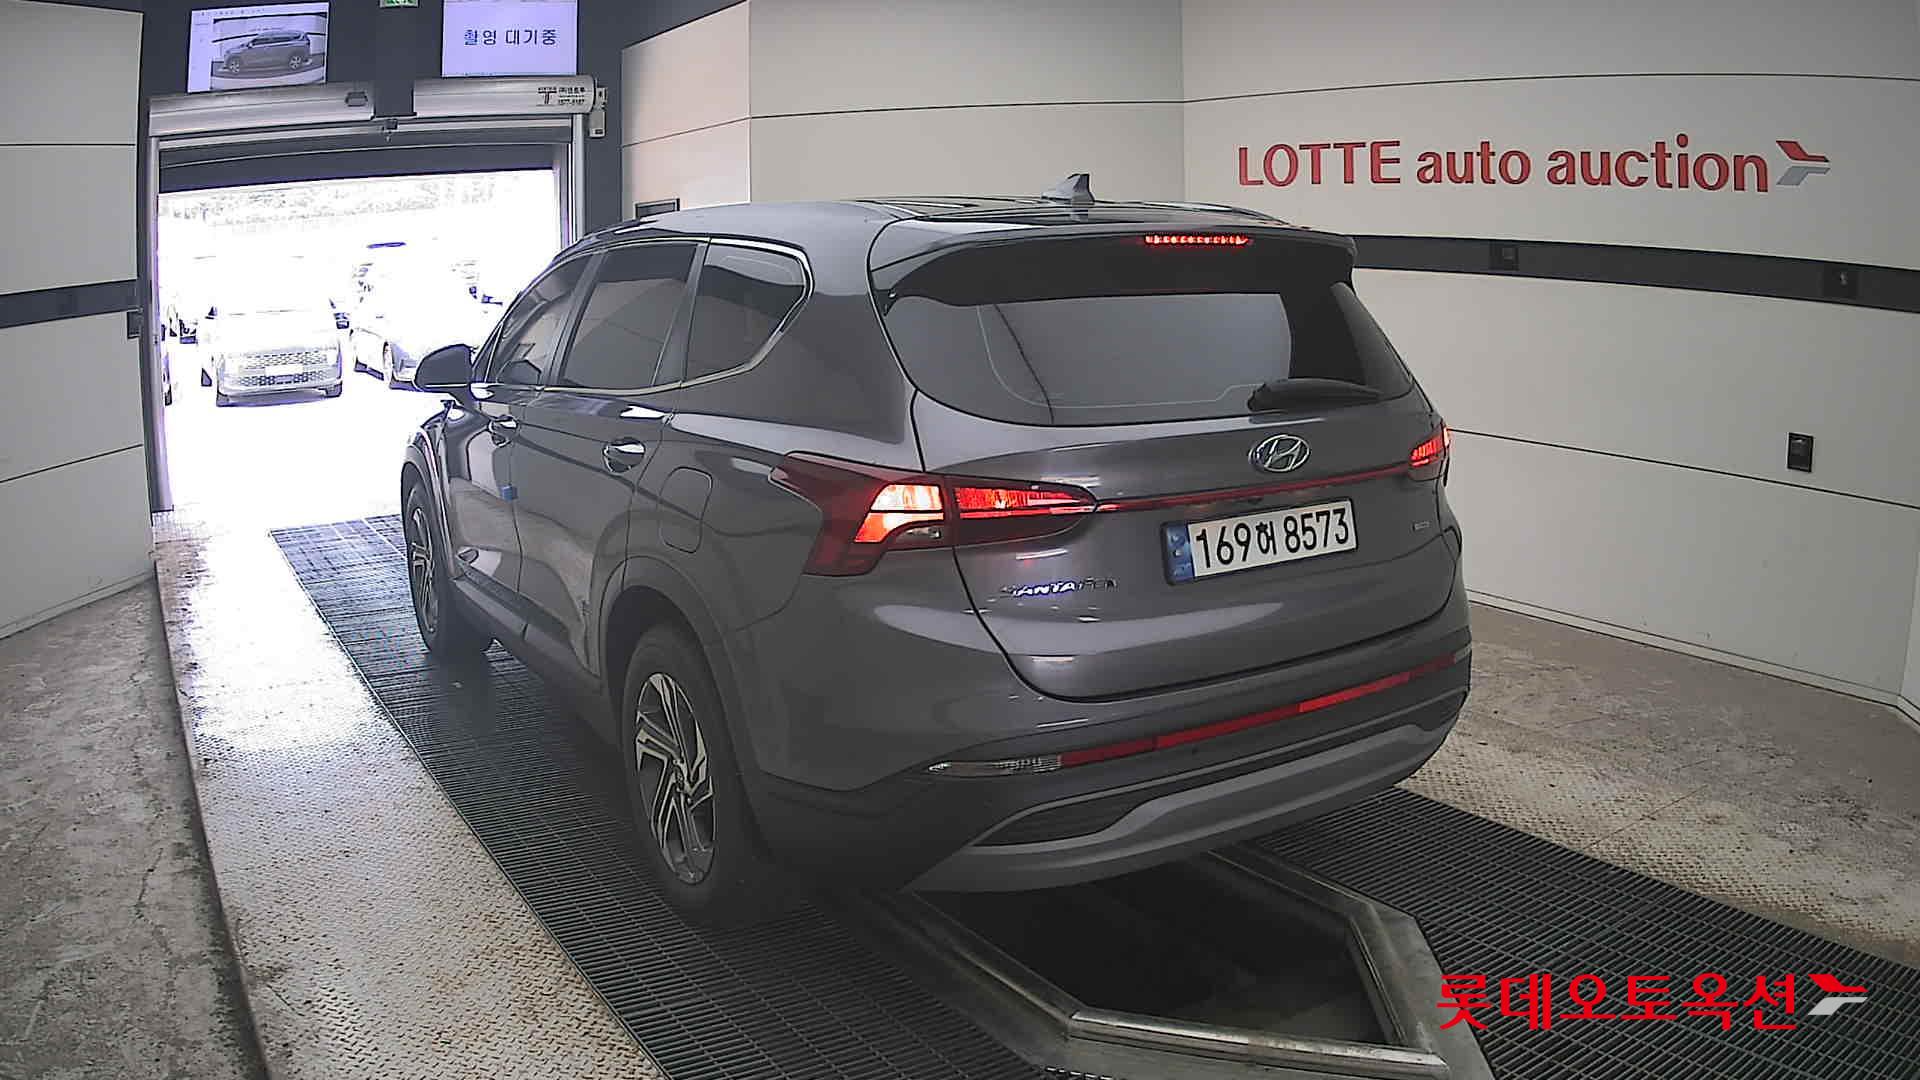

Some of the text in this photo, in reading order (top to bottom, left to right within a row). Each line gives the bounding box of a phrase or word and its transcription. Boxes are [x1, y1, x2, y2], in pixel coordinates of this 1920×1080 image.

[505, 29, 557, 46] 대기중
[1238, 133, 1768, 192] LOTTE auto auction
[1195, 507, 1350, 569] 169허 8573
